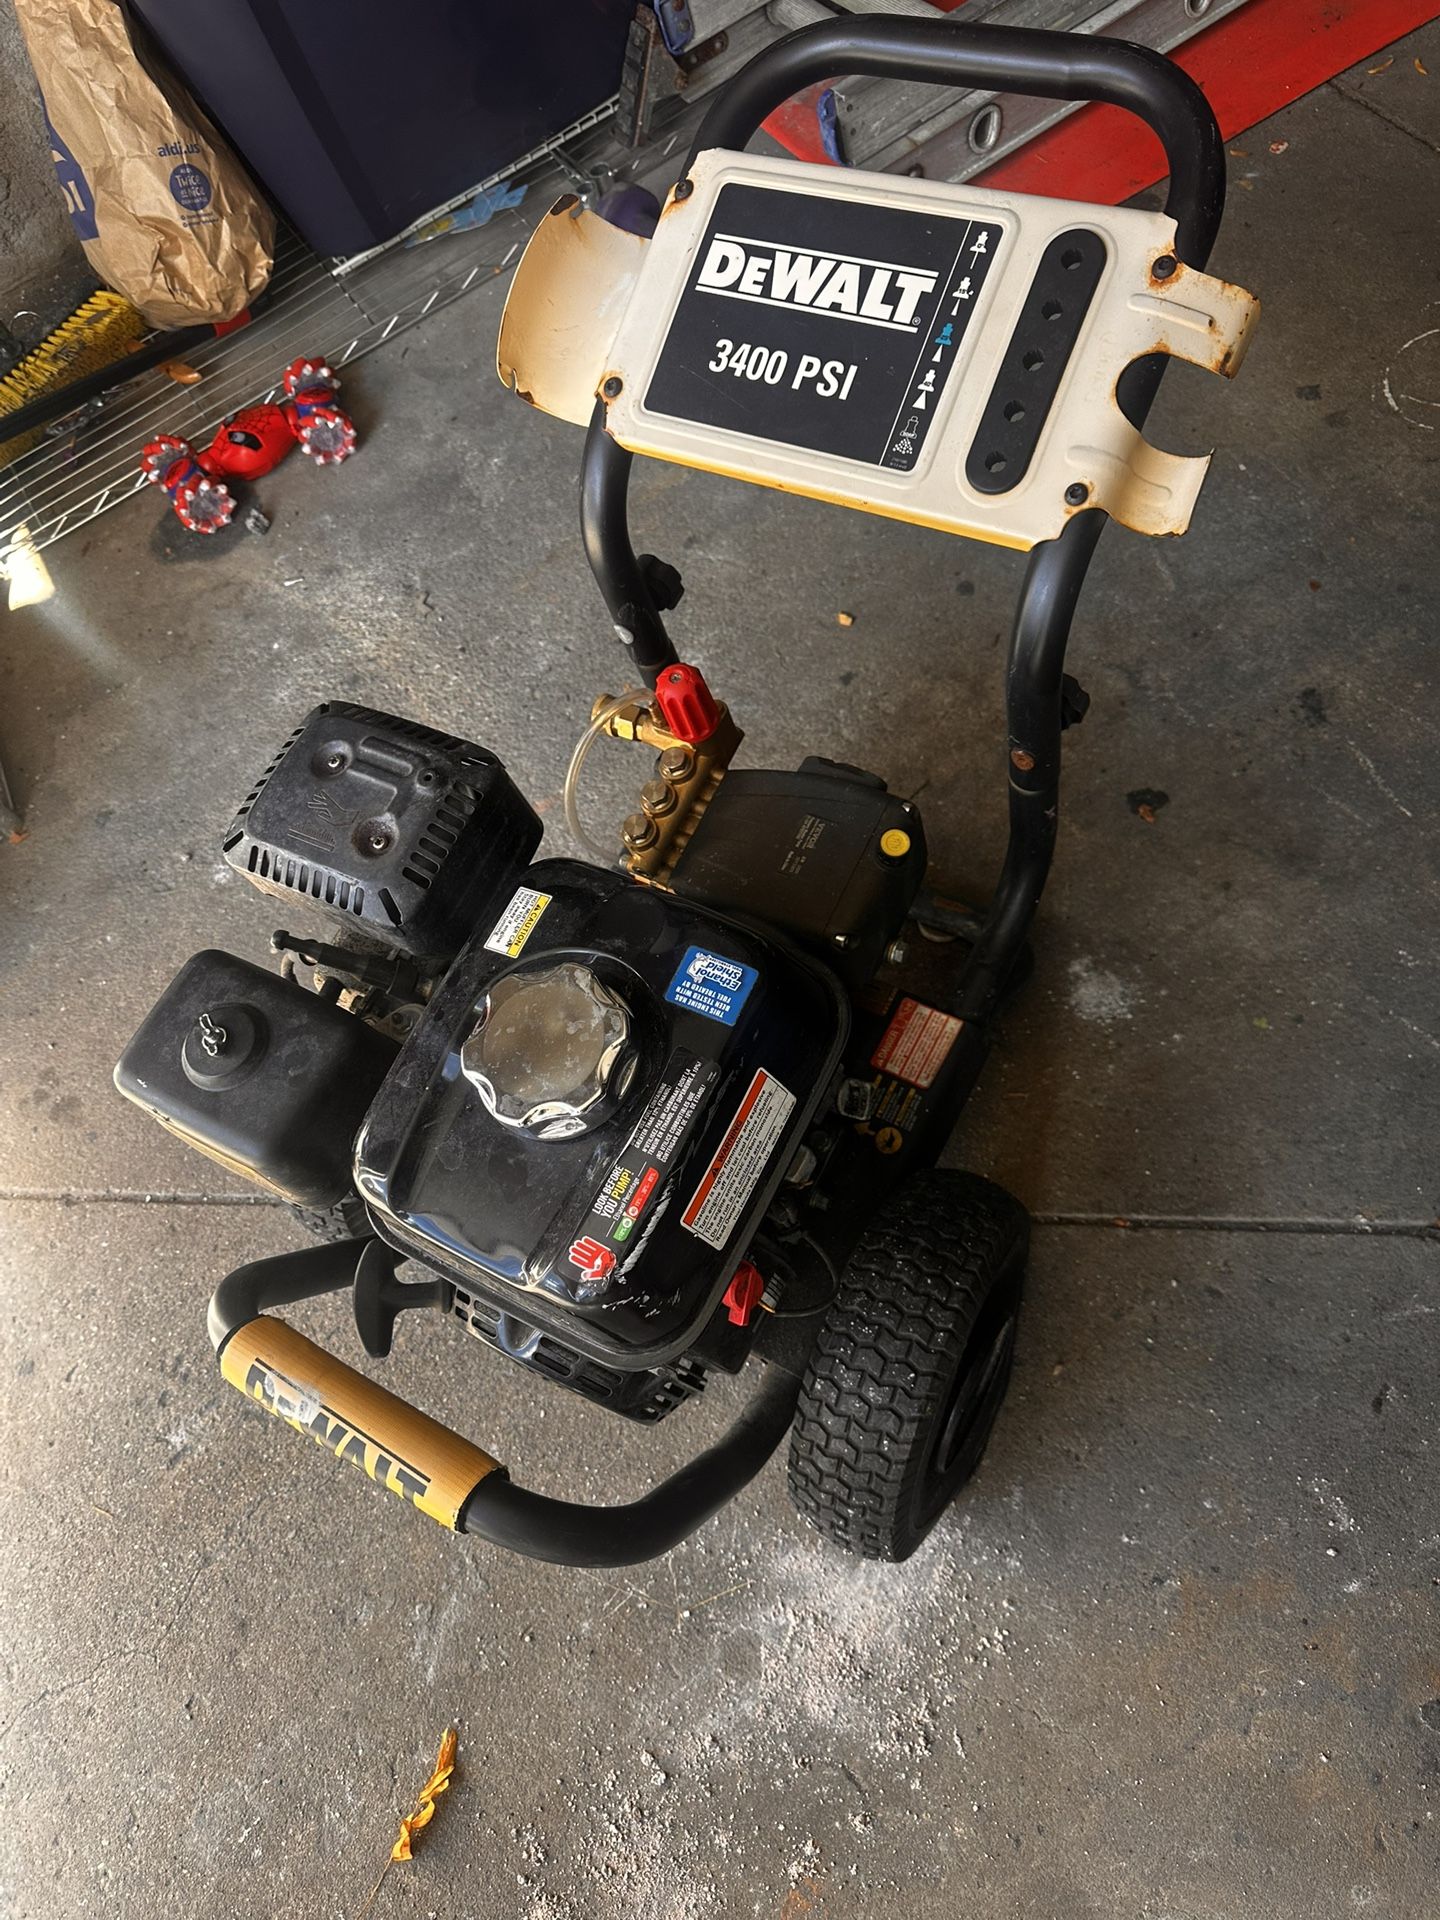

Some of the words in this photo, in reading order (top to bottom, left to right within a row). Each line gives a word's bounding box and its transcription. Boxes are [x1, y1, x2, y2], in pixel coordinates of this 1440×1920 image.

[158, 141, 201, 157] aldi.us
[175, 174, 201, 188] Twice
[186, 185, 206, 198] Nice
[708, 338, 787, 387] 3400
[791, 352, 859, 401] PSI
[522, 894, 532, 909] BURN
[505, 934, 514, 947] CAN
[513, 911, 537, 946] CAUTION
[695, 967, 739, 990] Ethanol
[705, 960, 739, 980] Shield
[674, 993, 687, 1003] HAS
[675, 986, 692, 996] WITH
[687, 999, 709, 1011] ENGINE
[690, 983, 716, 997] TREATED
[692, 992, 714, 1005] TESTED
[714, 1000, 730, 1011] BEEN
[716, 993, 731, 1003] FUEL
[709, 1007, 723, 1017] THIS
[633, 1127, 648, 1148] GREATER
[644, 1115, 655, 1128] THAN
[651, 1106, 660, 1116] 10%
[656, 1084, 672, 1106] ETHANOL!
[643, 1108, 652, 1120] FUEL
[649, 1082, 667, 1108] CONTAINING
[654, 1118, 663, 1128] PAS
[663, 1086, 681, 1113] CARBURANT
[647, 1137, 660, 1155] TENEUR
[656, 1130, 663, 1138] EN
[670, 1102, 679, 1111] EST
[659, 1133, 672, 1150] UTILICE
[668, 1100, 690, 1133] COMBUSTIBLES
[686, 1091, 695, 1101] QUE
[660, 1135, 678, 1162] CONTENGAN
[684, 1108, 693, 1119] 10%
[716, 1118, 743, 1163] WARNING
[591, 1192, 609, 1214] LOOK
[602, 1163, 624, 1194] BEFORE
[693, 1197, 710, 1226] Gasoline
[712, 1169, 725, 1190] highly
[722, 1133, 743, 1168] flammable
[741, 1119, 750, 1132] and
[699, 1214, 709, 1229] Turn
[707, 1191, 721, 1214] engine
[724, 1166, 733, 1179] and
[736, 1141, 746, 1156] cool
[744, 1119, 757, 1141] before
[705, 1221, 714, 1233] The
[712, 1197, 726, 1220] engine
[723, 1178, 735, 1197] emits
[733, 1161, 744, 1177] toxic
[742, 1137, 756, 1160] carbon
[600, 1198, 618, 1219] YOU
[610, 1168, 634, 1200] PUMP!
[612, 1201, 627, 1221] Ethanol
[622, 1176, 641, 1203] Percentage
[710, 1229, 717, 1237] Do
[715, 1215, 723, 1227] not
[722, 1203, 730, 1215] run
[732, 1186, 738, 1194] an
[736, 1155, 754, 1185] enclosed
[715, 1224, 726, 1241] Read
[737, 1175, 751, 1198] Manual
[749, 1155, 762, 1175] before
